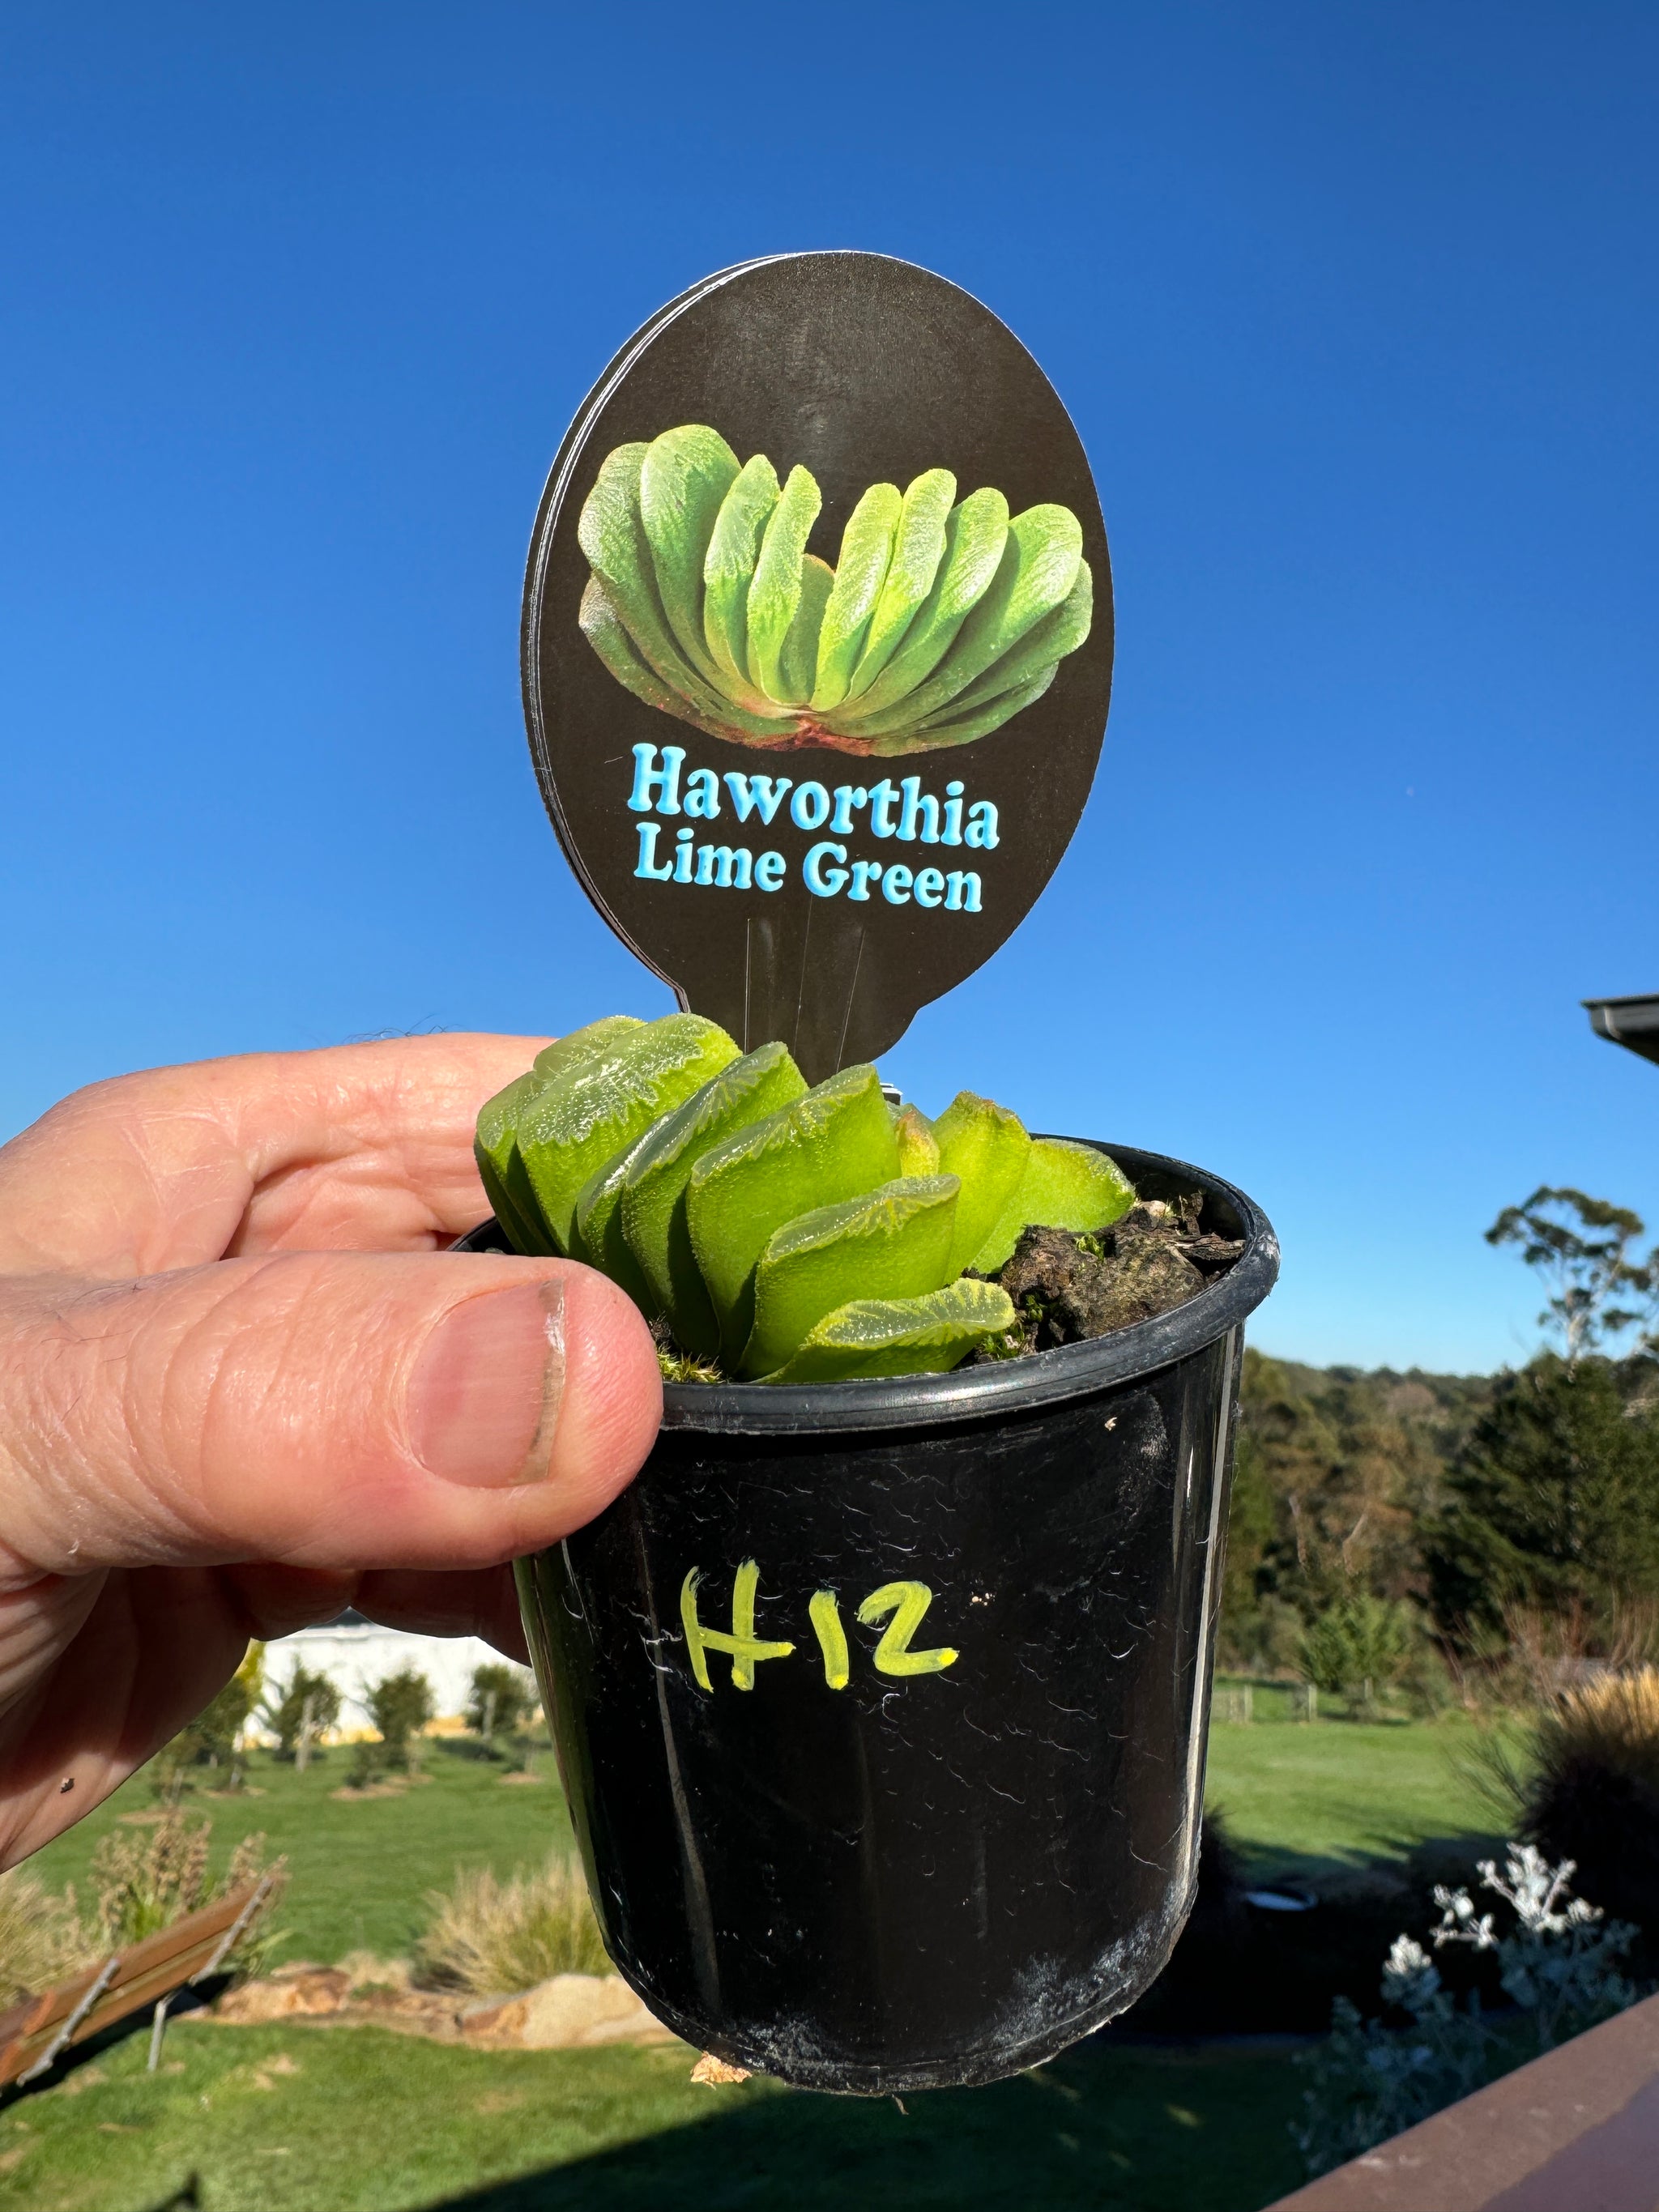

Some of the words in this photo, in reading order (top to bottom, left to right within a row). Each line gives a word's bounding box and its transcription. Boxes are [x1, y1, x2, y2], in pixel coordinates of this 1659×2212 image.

[627, 743, 1000, 850] Haworthia
[633, 822, 787, 892] Lime
[803, 842, 983, 913] Green
[680, 1560, 959, 1693] H12
